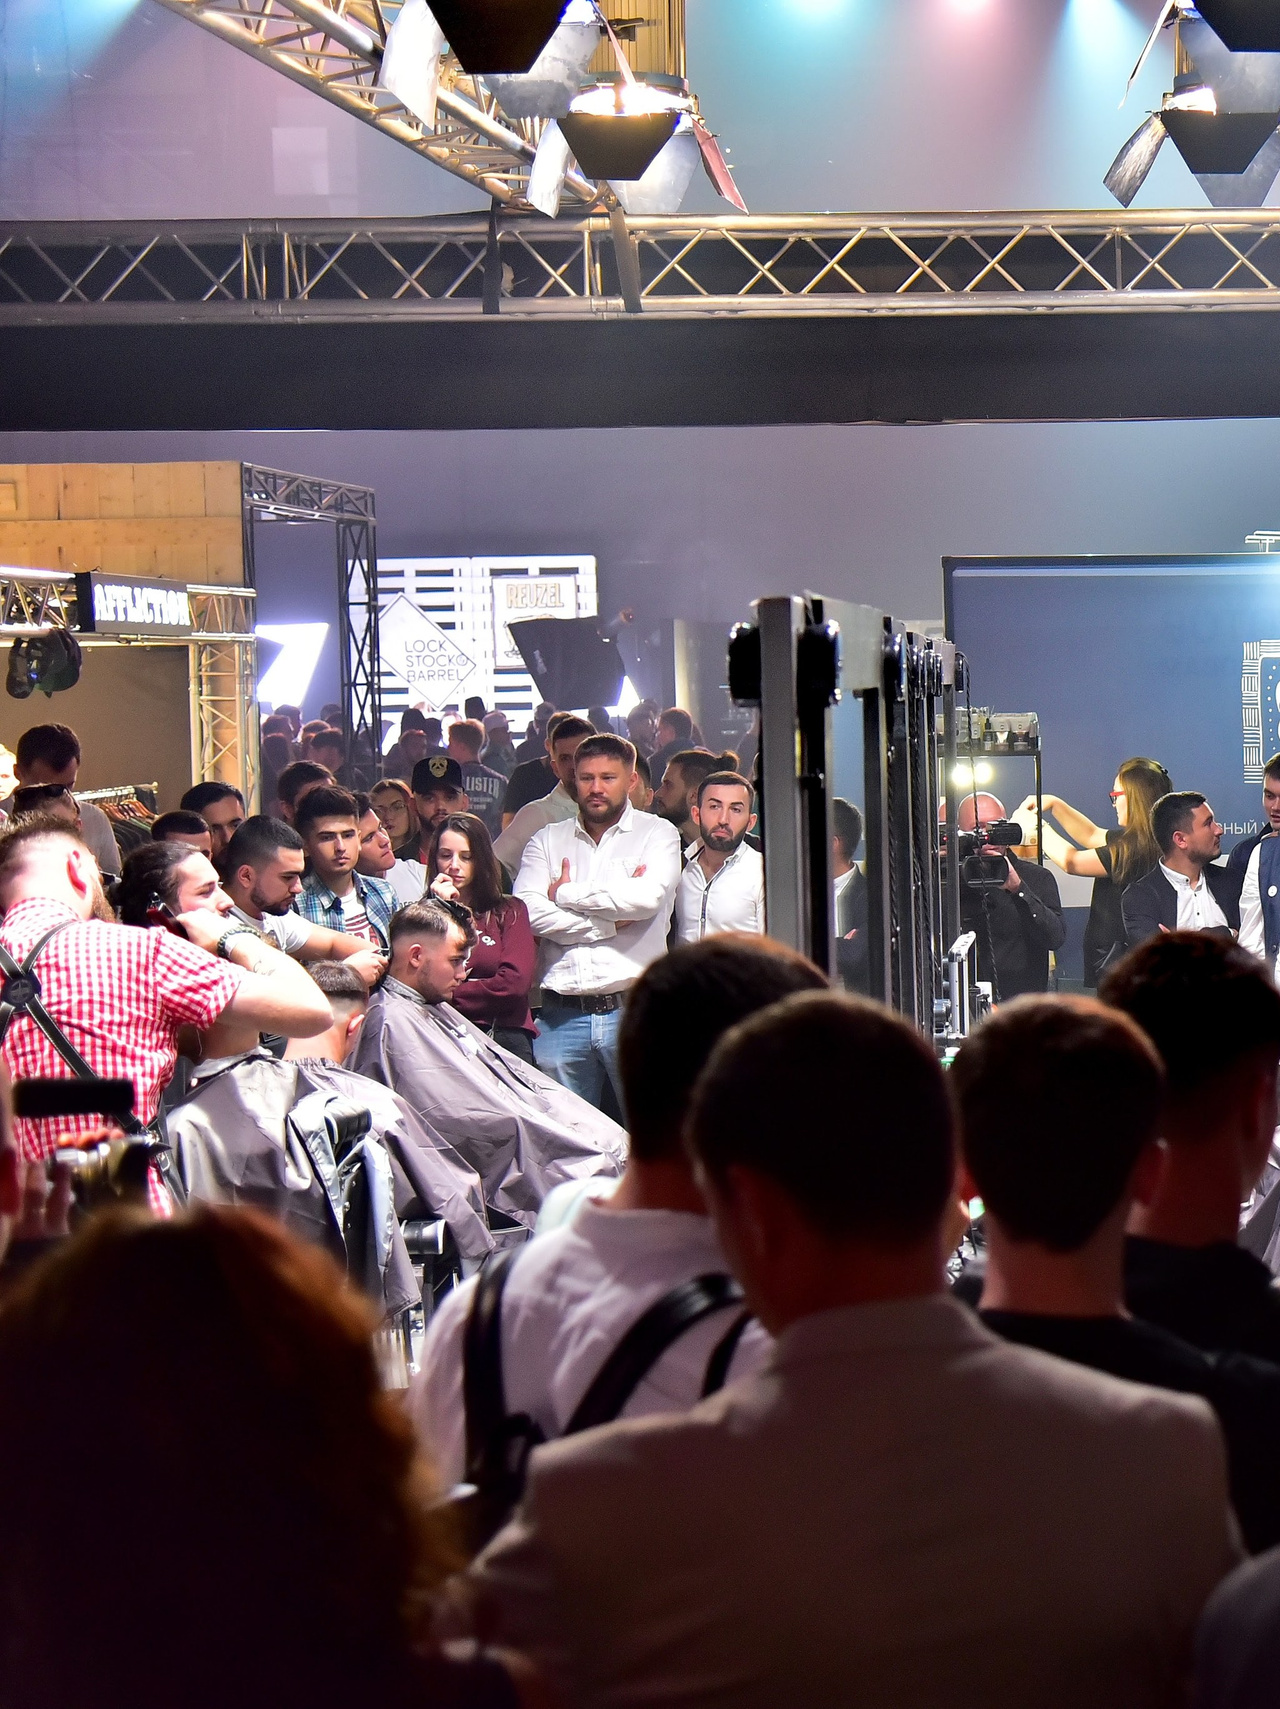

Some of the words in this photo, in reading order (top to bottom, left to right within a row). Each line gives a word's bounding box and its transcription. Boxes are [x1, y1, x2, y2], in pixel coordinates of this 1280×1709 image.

[94, 584, 191, 626] AFFLICTION
[506, 583, 564, 609] REUZEL
[404, 639, 447, 653] LOCK
[406, 654, 456, 668] STOCK
[407, 669, 463, 682] BARREL
[465, 776, 500, 799] LISTER
